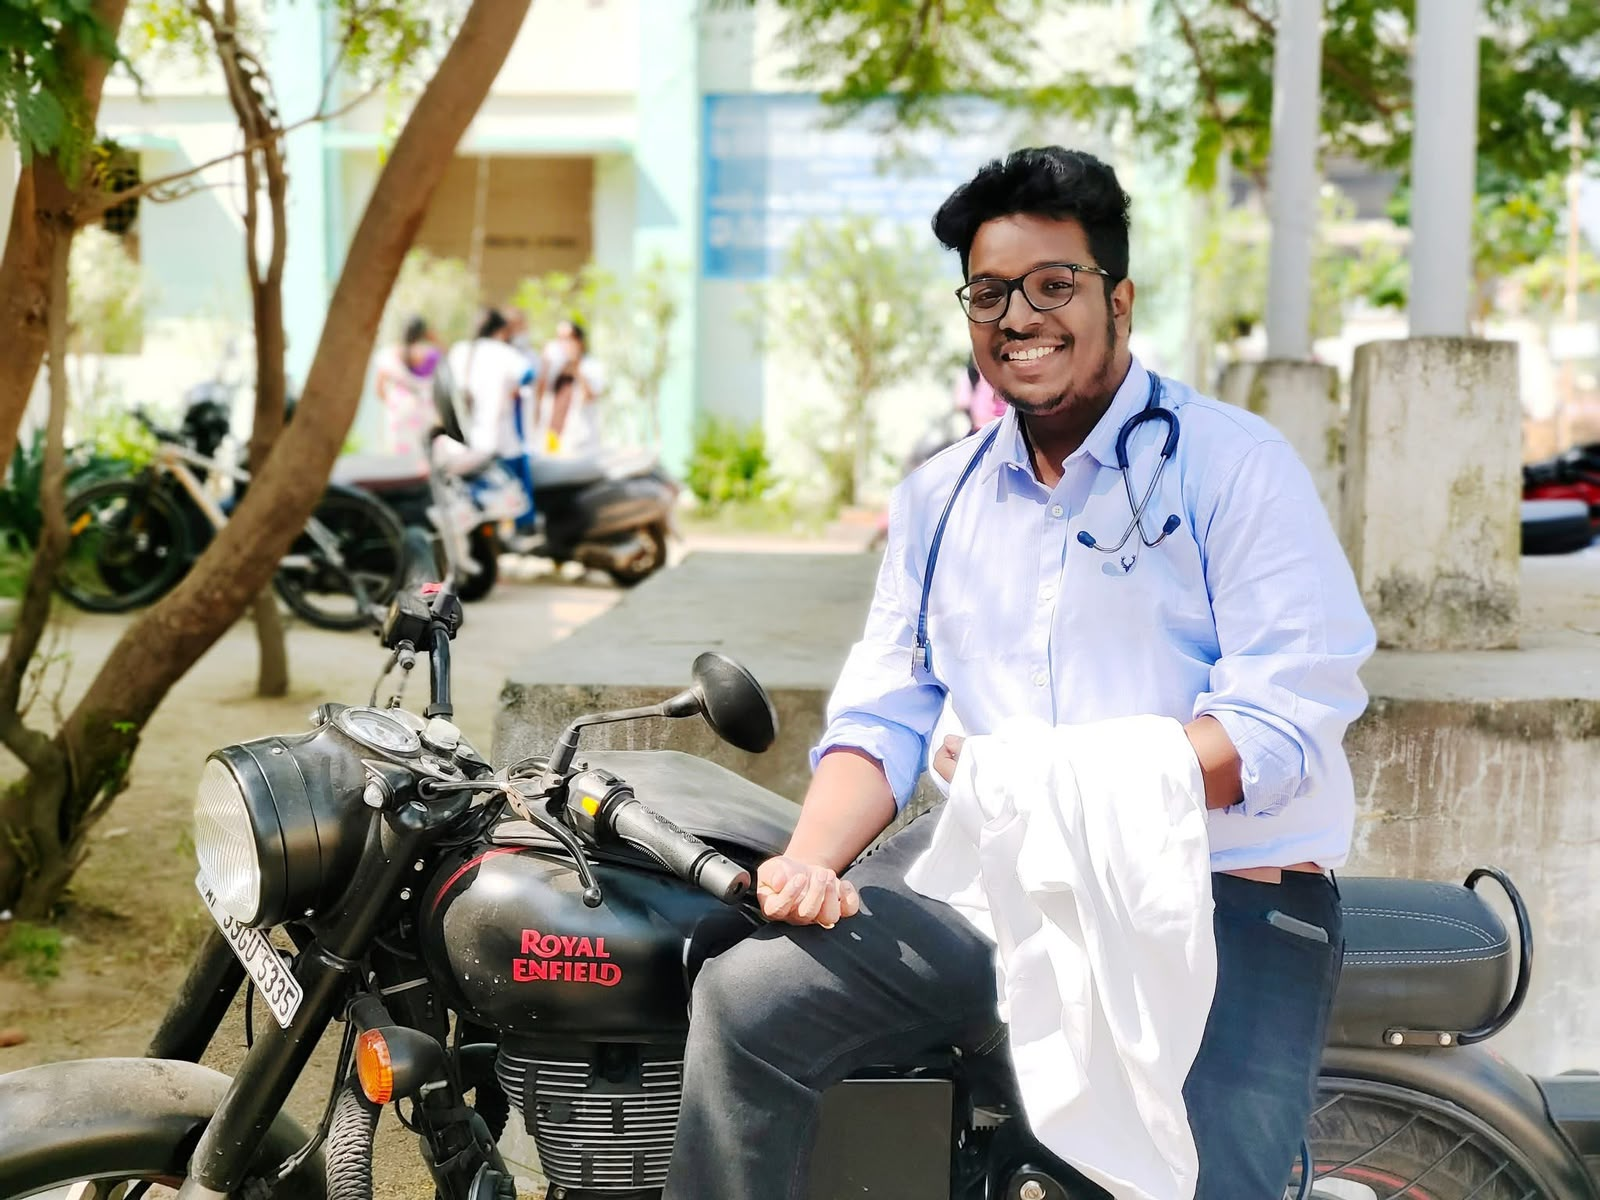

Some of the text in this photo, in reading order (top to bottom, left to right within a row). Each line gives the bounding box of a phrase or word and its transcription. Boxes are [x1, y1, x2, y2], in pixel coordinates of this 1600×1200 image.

[520, 928, 611, 959] ROYAL
[257, 954, 295, 1017] 5335
[513, 958, 622, 988] ENFIELD
